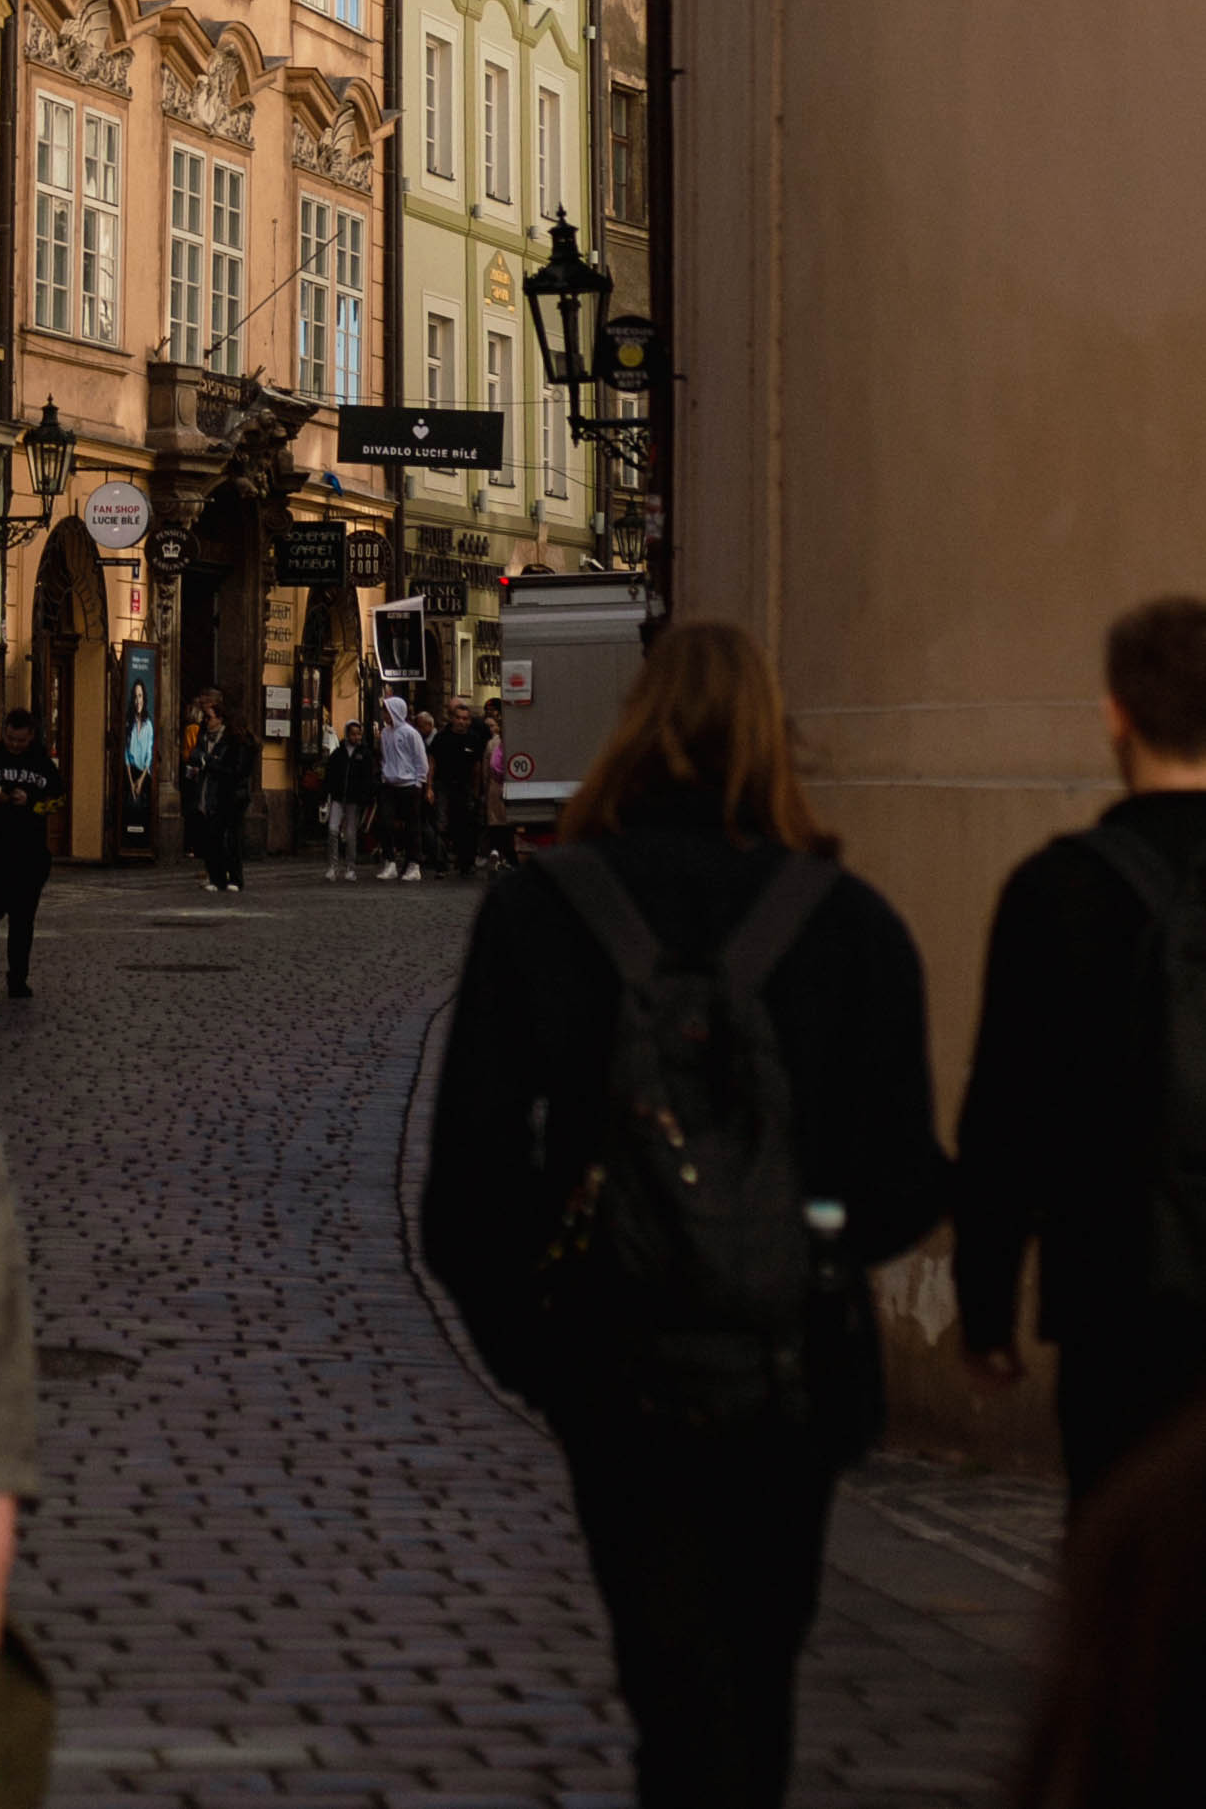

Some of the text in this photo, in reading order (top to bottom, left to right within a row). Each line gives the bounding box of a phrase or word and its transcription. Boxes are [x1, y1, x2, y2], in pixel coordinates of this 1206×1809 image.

[362, 444, 478, 460] DIVADLO LUCIE BÍLÉ
[93, 505, 140, 514] FAN SHOP
[92, 516, 118, 525] LUCIE
[349, 543, 379, 558] GOOD
[288, 558, 338, 569] MUSEUM
[349, 559, 379, 575] FOOD
[415, 584, 459, 597] MUSIC
[426, 597, 463, 611] LUB
[513, 760, 528, 772] 90
